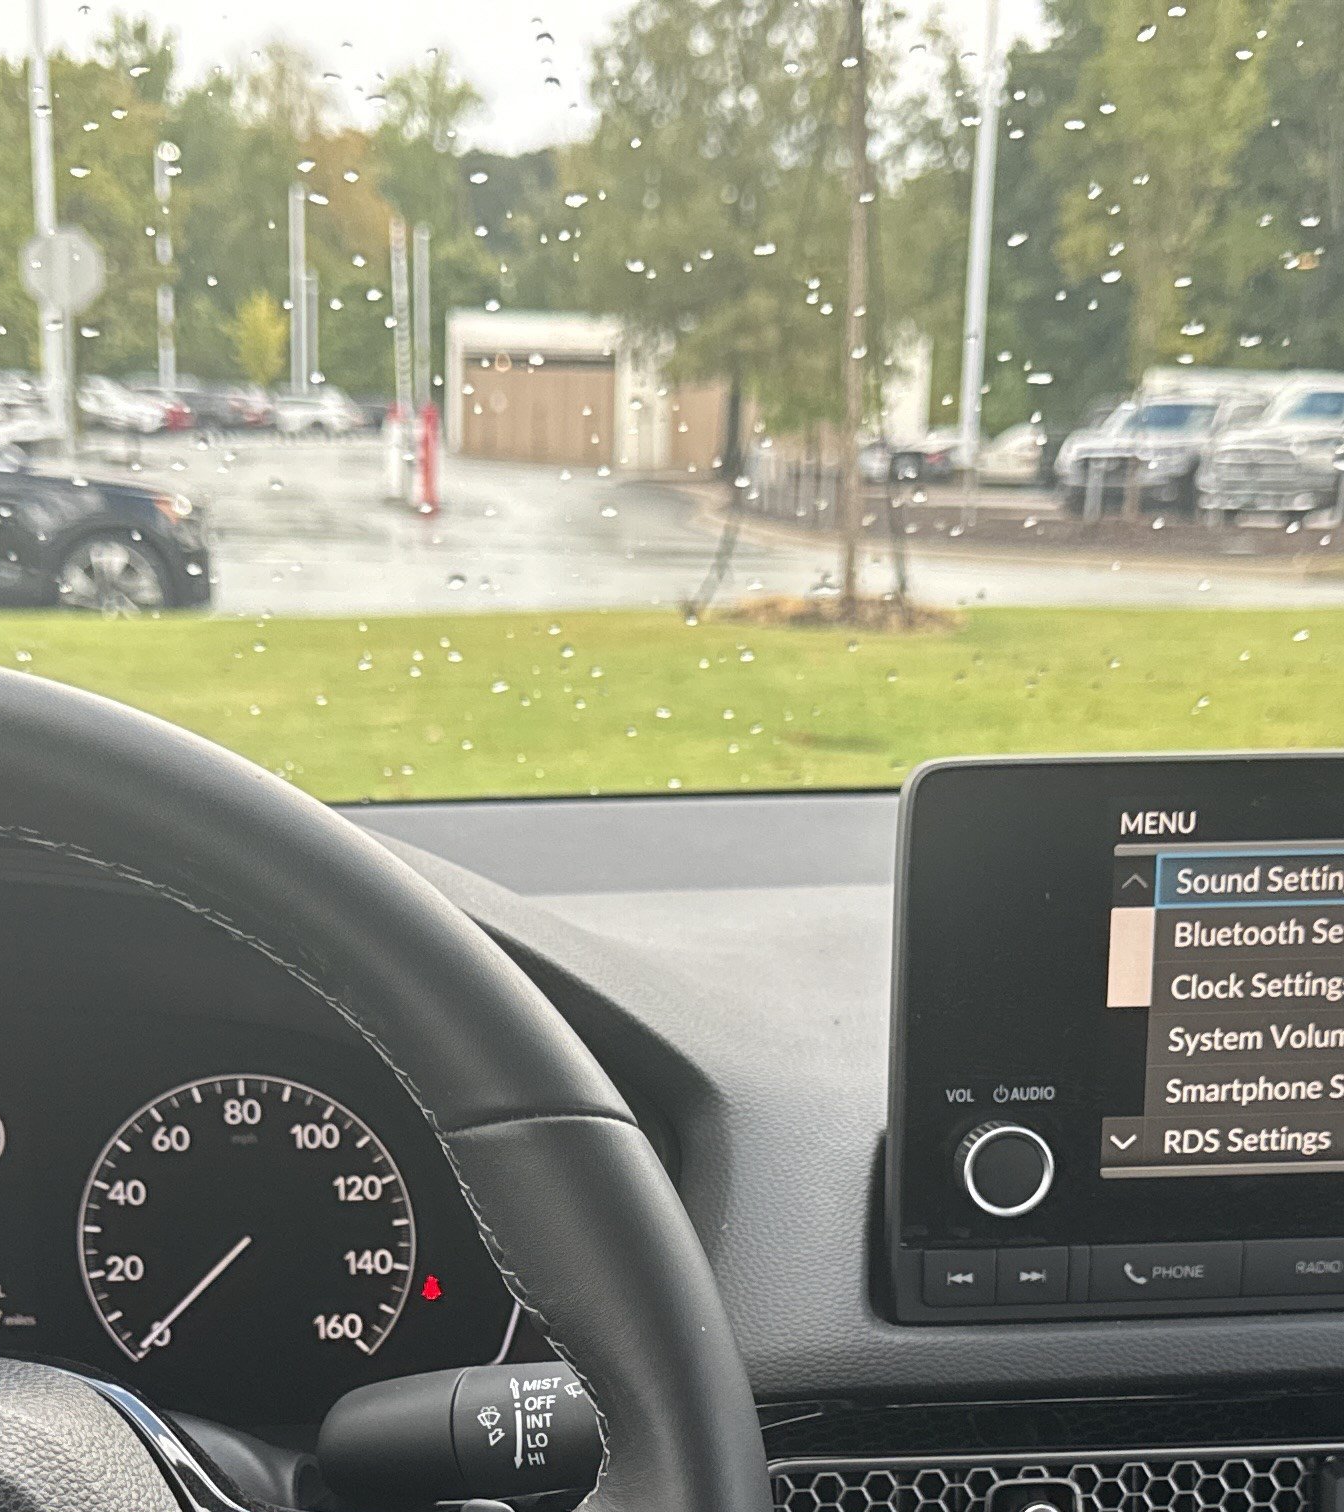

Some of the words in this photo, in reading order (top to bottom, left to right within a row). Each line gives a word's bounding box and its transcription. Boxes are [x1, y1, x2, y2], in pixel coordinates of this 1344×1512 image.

[1120, 811, 1197, 835] MENU
[1176, 866, 1261, 894] Sound
[1174, 918, 1305, 947] Bluetooth
[1171, 972, 1245, 1001] Clock
[1168, 1026, 1263, 1056] System
[946, 1089, 974, 1103] VOL
[1010, 1086, 1055, 1101] AUDIO
[1165, 1076, 1322, 1106] Smartphone
[224, 1101, 262, 1125] 80
[152, 1126, 191, 1152] 60
[291, 1123, 340, 1150] 100
[1164, 1128, 1220, 1154] RDS
[1227, 1126, 1331, 1156] Settings
[107, 1180, 146, 1206] 40
[333, 1175, 383, 1201] 120
[105, 1256, 144, 1281] 20
[344, 1250, 393, 1275] 140
[1152, 1264, 1205, 1279] PHONE
[1295, 1260, 1344, 1274] RADIO
[313, 1315, 363, 1341] 160
[522, 1376, 562, 1392] MIST
[524, 1395, 556, 1411] OFF
[526, 1413, 553, 1429] INT
[526, 1432, 549, 1449] LO
[528, 1451, 546, 1466] HI
